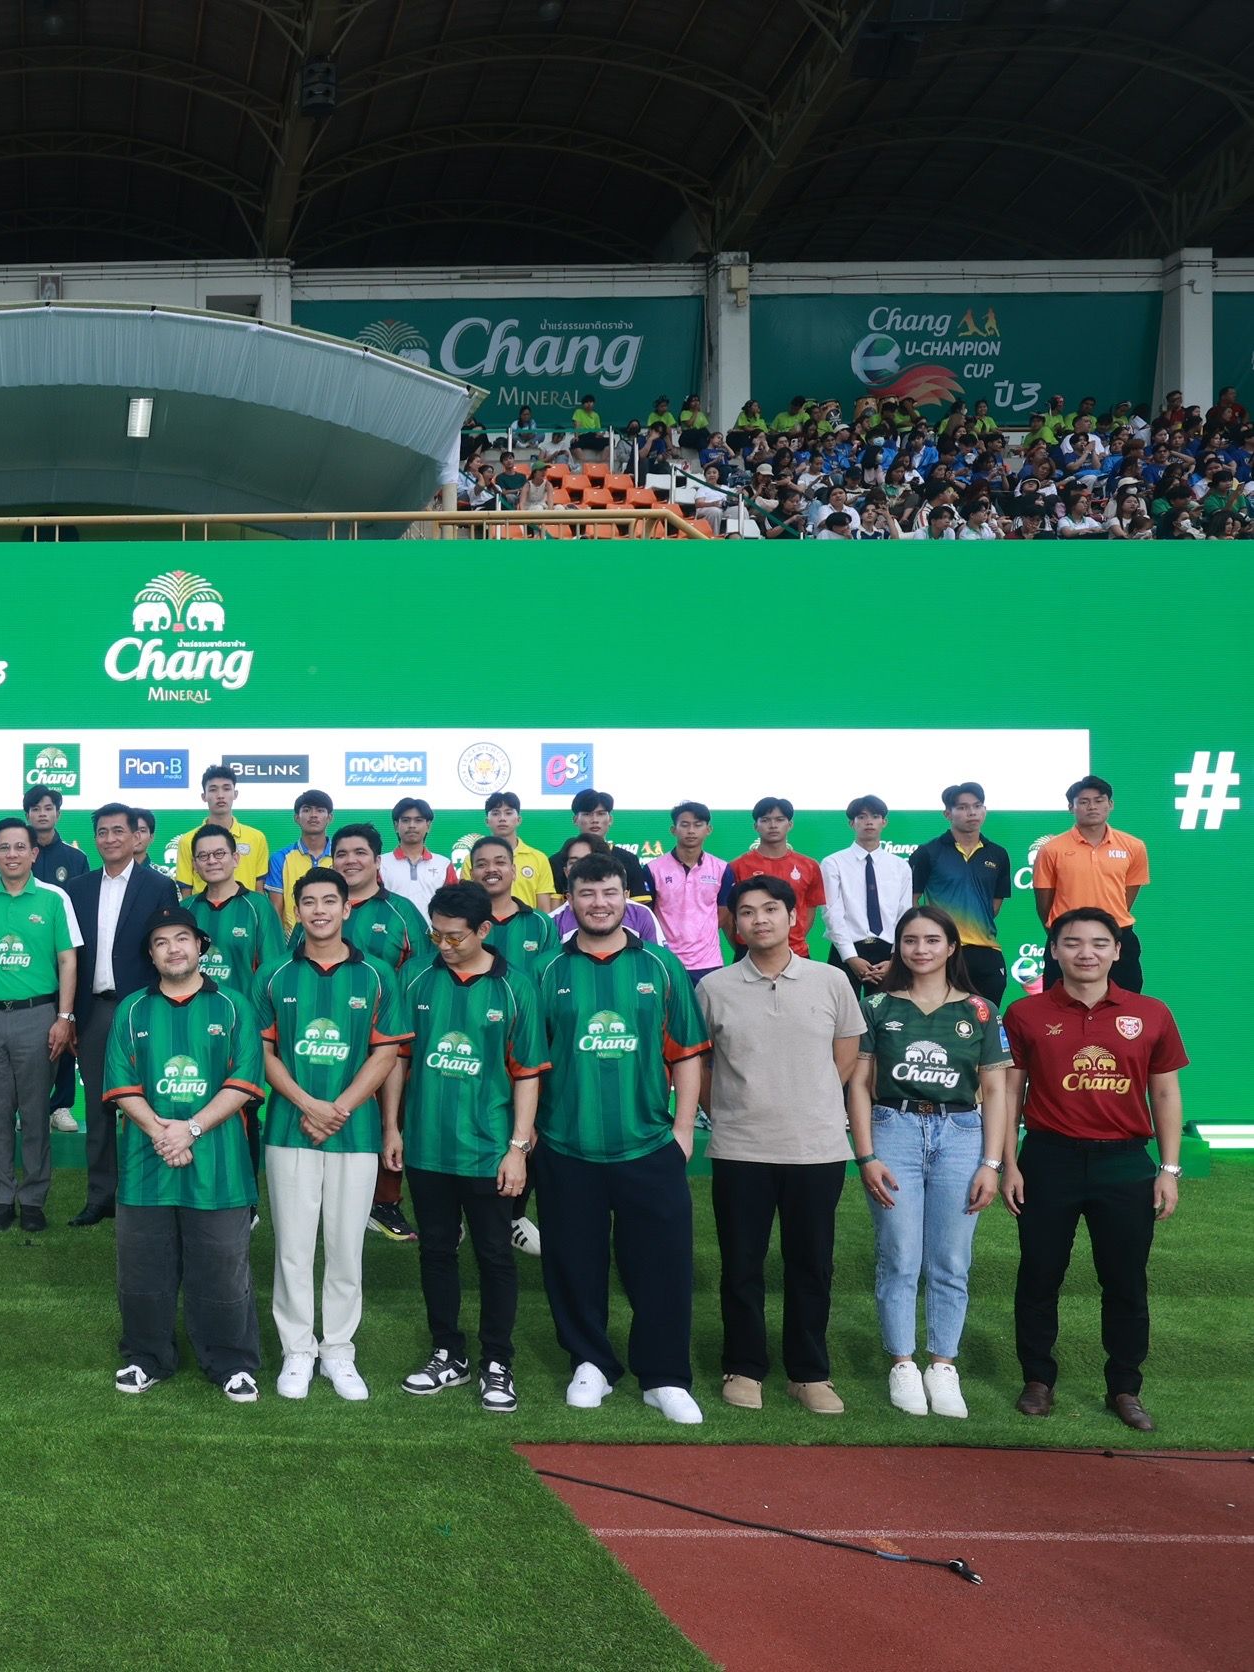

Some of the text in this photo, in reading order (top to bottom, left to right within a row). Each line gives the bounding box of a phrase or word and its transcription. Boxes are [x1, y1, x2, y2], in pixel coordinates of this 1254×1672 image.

[867, 306, 952, 337] Chang
[440, 317, 644, 390] Chang
[904, 341, 1002, 356] U-CHAMPION
[963, 363, 995, 378] CUP
[497, 386, 582, 409] MINERAL
[994, 380, 1042, 412] ปี 3
[104, 637, 255, 690] Chang
[147, 686, 212, 704] MINERAL
[230, 762, 301, 776] BELINK
[349, 754, 423, 772] molten
[546, 752, 589, 787] est
[26, 769, 77, 788] Chang
[363, 774, 377, 783] the
[378, 773, 397, 783] real
[397, 776, 423, 785] game
[1174, 751, 1241, 830] #
[1108, 849, 1128, 859] KBU
[1019, 943, 1045, 957] Cha
[198, 964, 231, 979] hang
[294, 1040, 350, 1060] Chang
[578, 1035, 638, 1052] Chang
[426, 1053, 483, 1075] Chang
[892, 1062, 960, 1089] Chang
[1062, 1074, 1132, 1095] Chang
[156, 1078, 208, 1096] Chang
